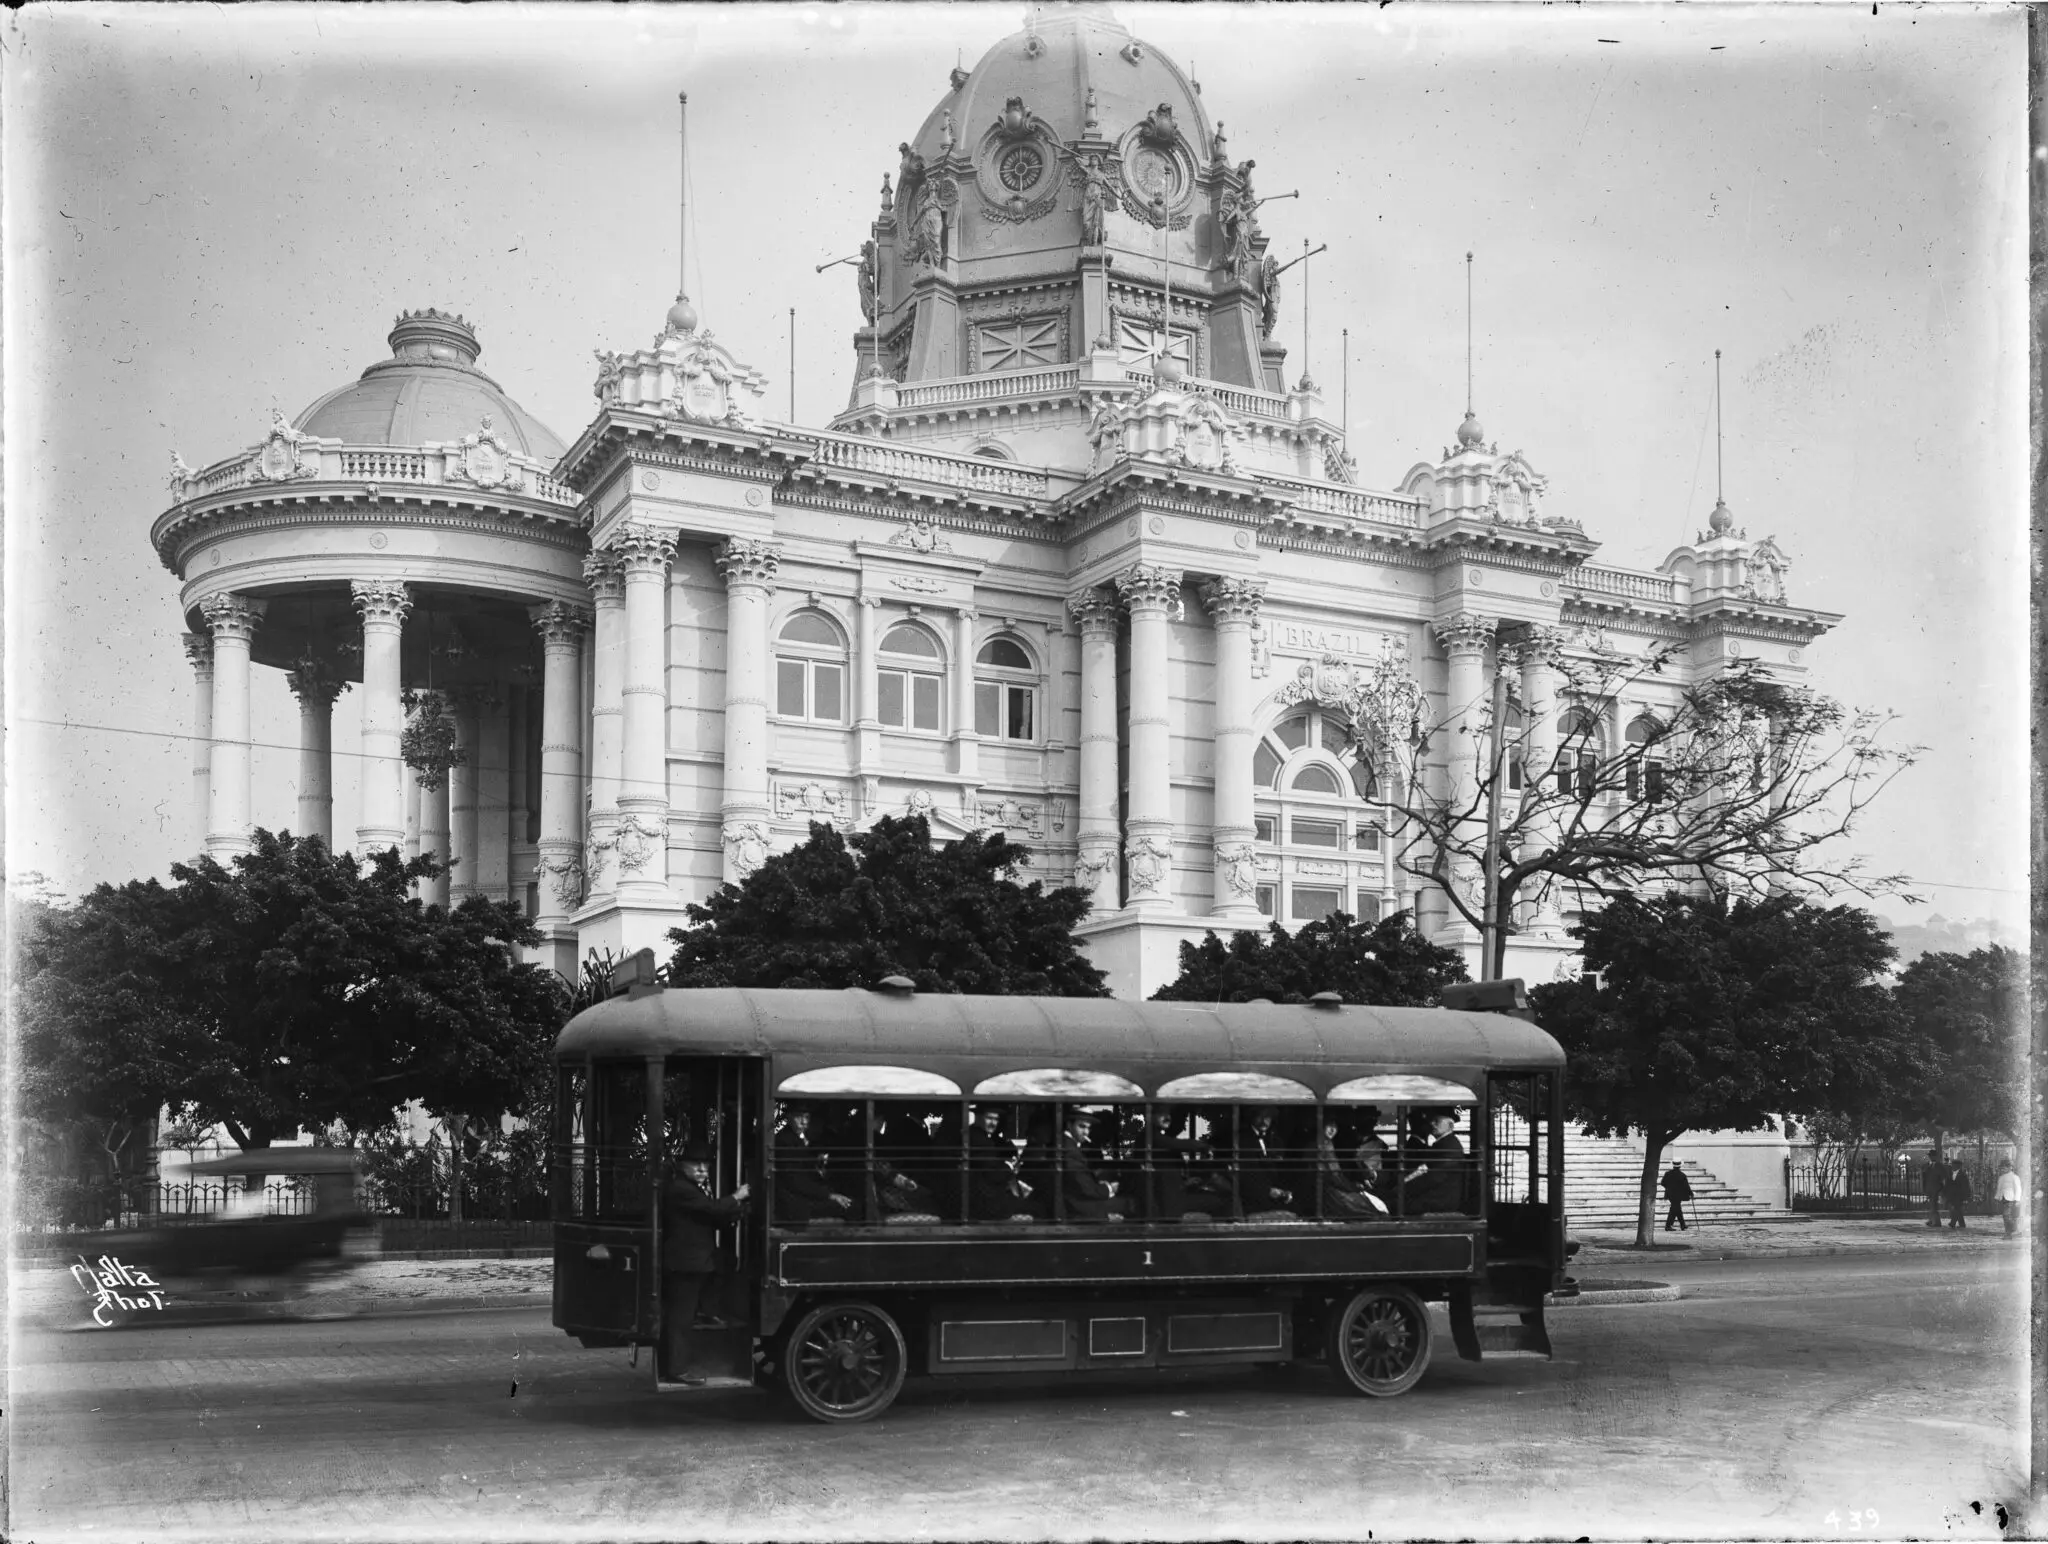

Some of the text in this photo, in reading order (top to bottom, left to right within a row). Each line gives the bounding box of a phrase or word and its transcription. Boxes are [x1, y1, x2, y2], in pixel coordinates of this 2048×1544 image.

[1286, 627, 1370, 656] BRAZIL
[622, 1256, 636, 1271] 1
[1141, 1250, 1156, 1266] 1
